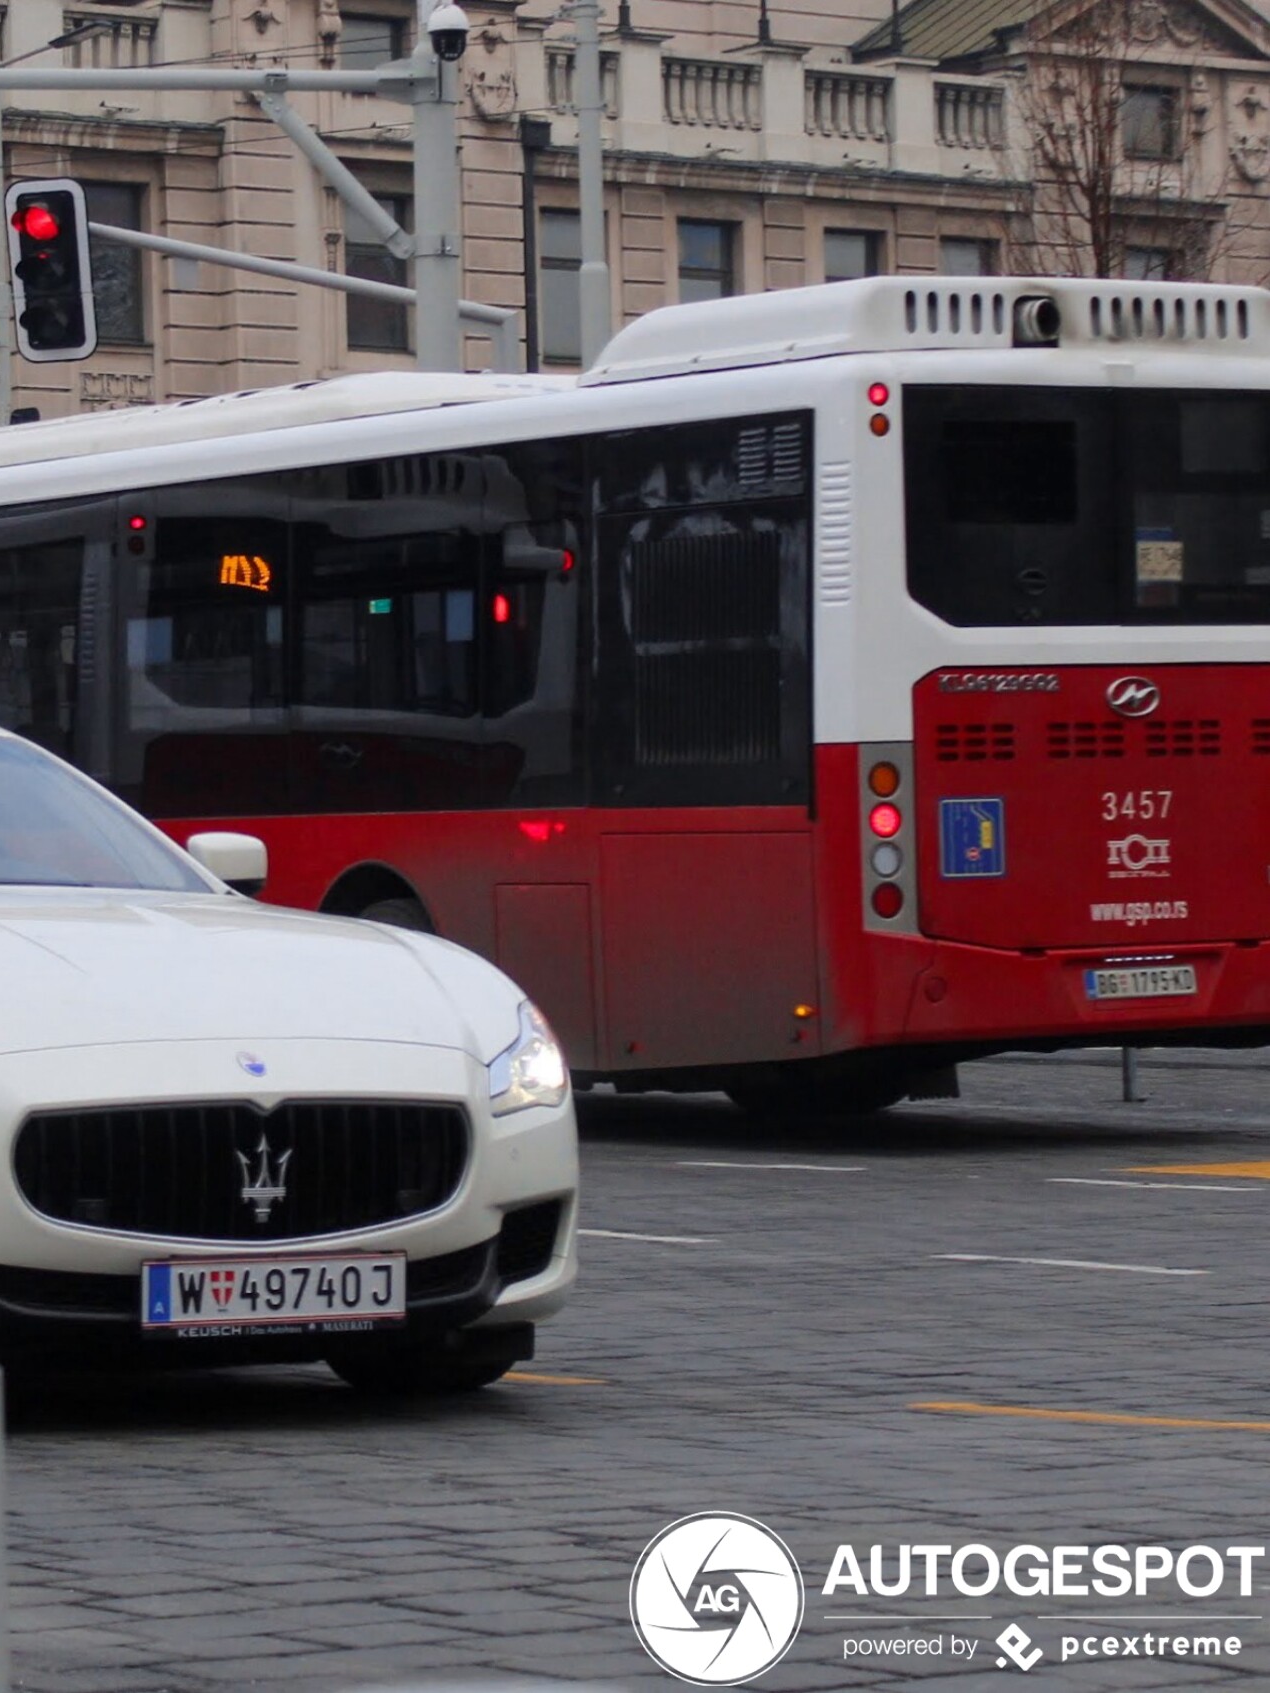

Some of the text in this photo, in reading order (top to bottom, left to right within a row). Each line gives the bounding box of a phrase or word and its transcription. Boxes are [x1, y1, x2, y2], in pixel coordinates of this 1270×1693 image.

[1102, 791, 1173, 820] 3457
[1090, 901, 1188, 926] www.gsp.co.rs
[1097, 973, 1119, 995] BG
[178, 1271, 206, 1314] W
[153, 1302, 165, 1314] A
[178, 1326, 242, 1337] KEUSCH
[323, 1321, 373, 1331] MASERATI
